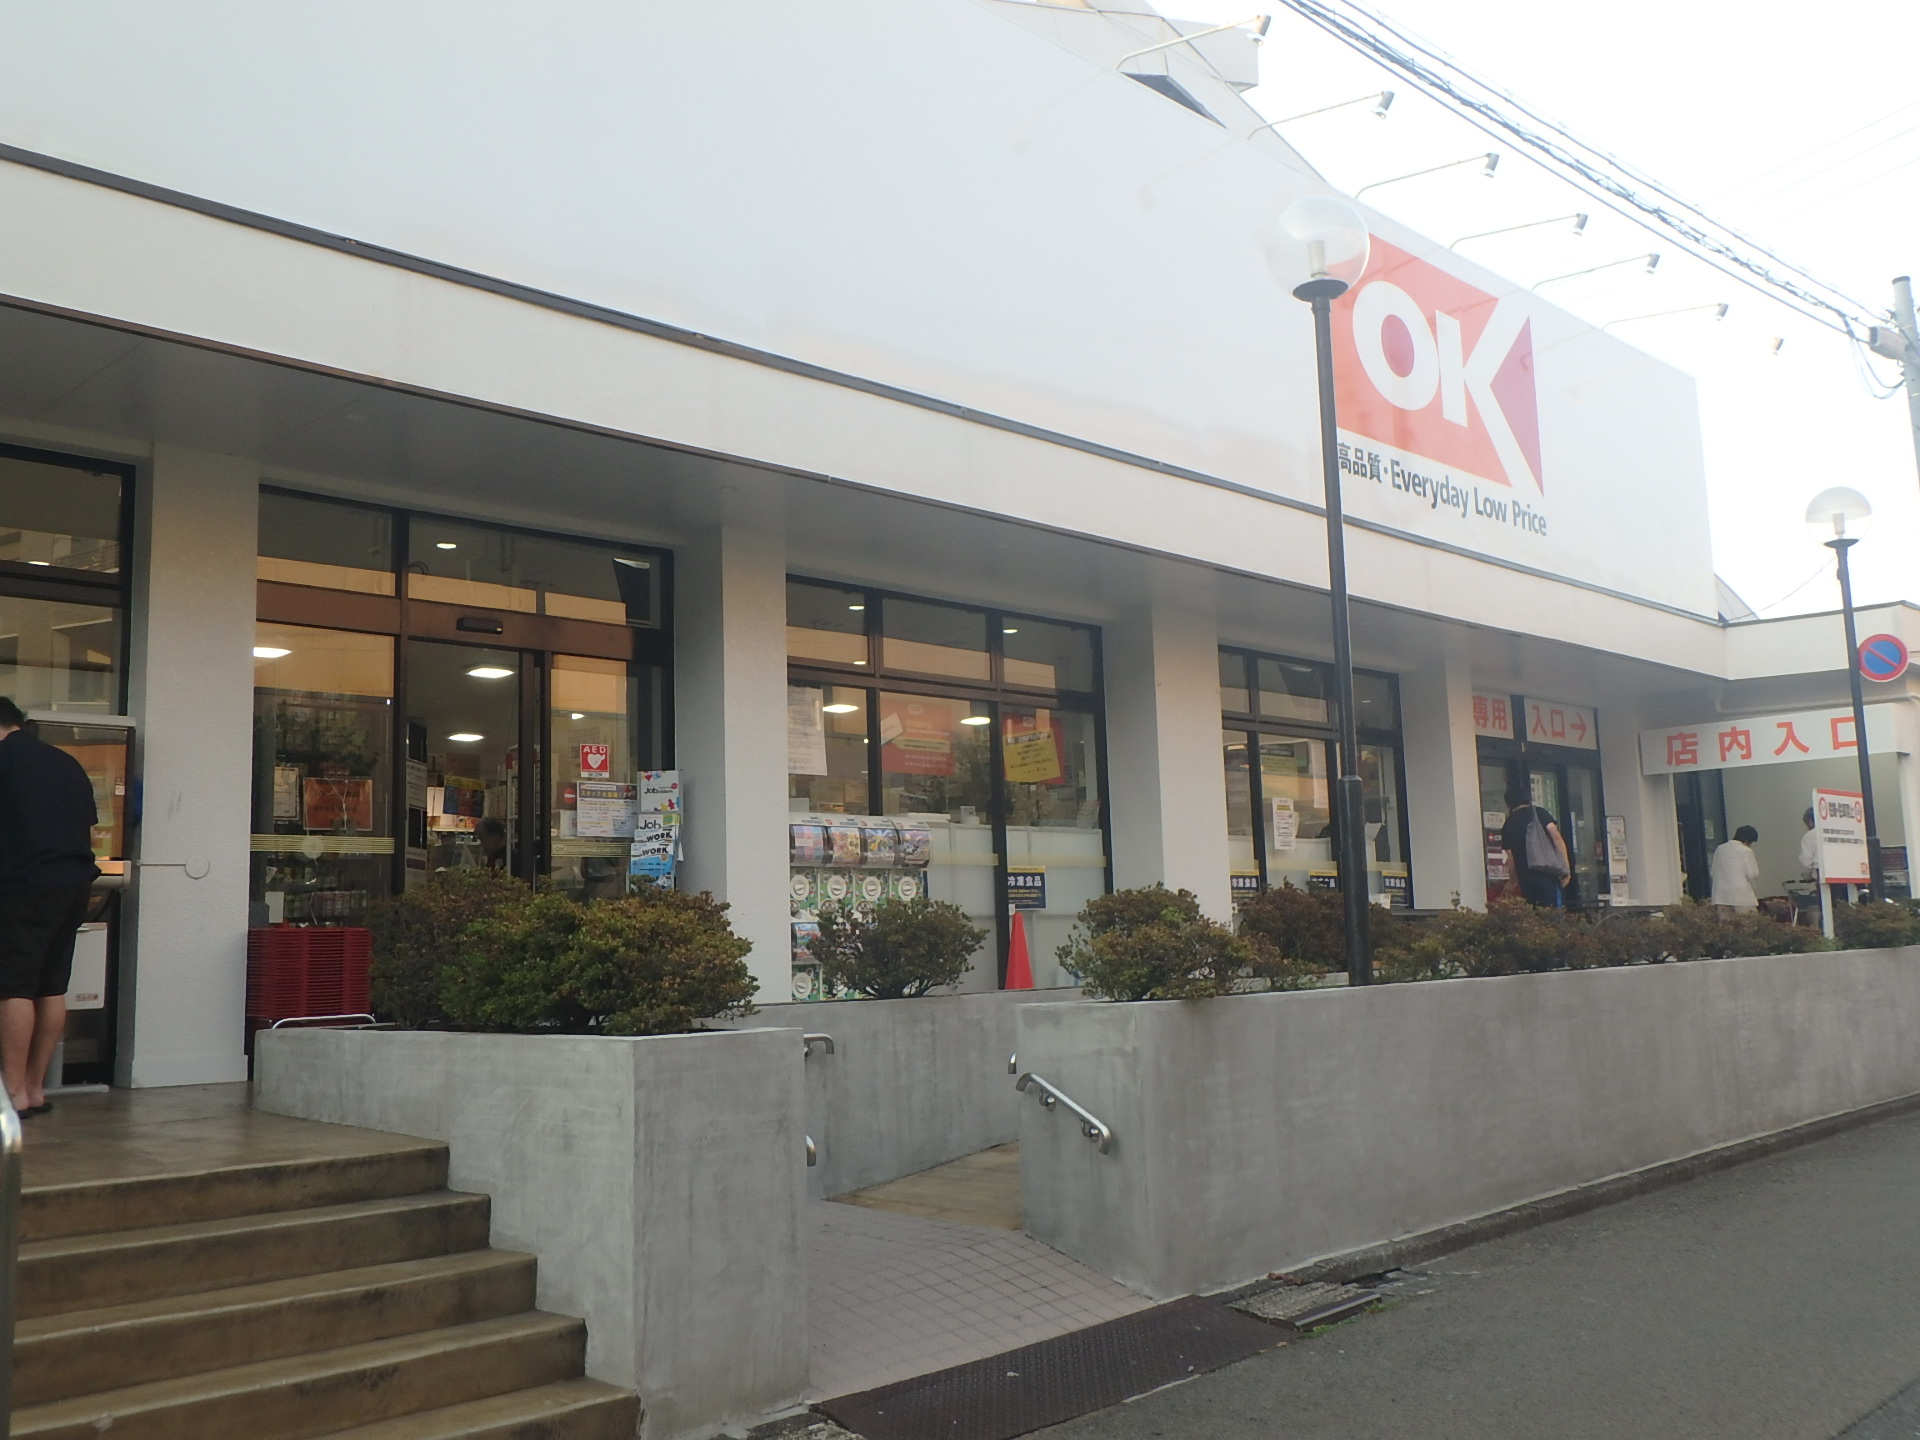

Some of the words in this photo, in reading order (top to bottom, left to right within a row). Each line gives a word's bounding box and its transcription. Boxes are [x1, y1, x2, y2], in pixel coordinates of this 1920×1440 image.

[1352, 280, 1543, 497] OK
[1390, 458, 1469, 518] Everyday
[1474, 487, 1507, 523] Low
[1512, 500, 1547, 537] Price
[1531, 704, 1566, 739] 入口
[1666, 716, 1858, 767] 店内入口
[583, 745, 607, 754] AED
